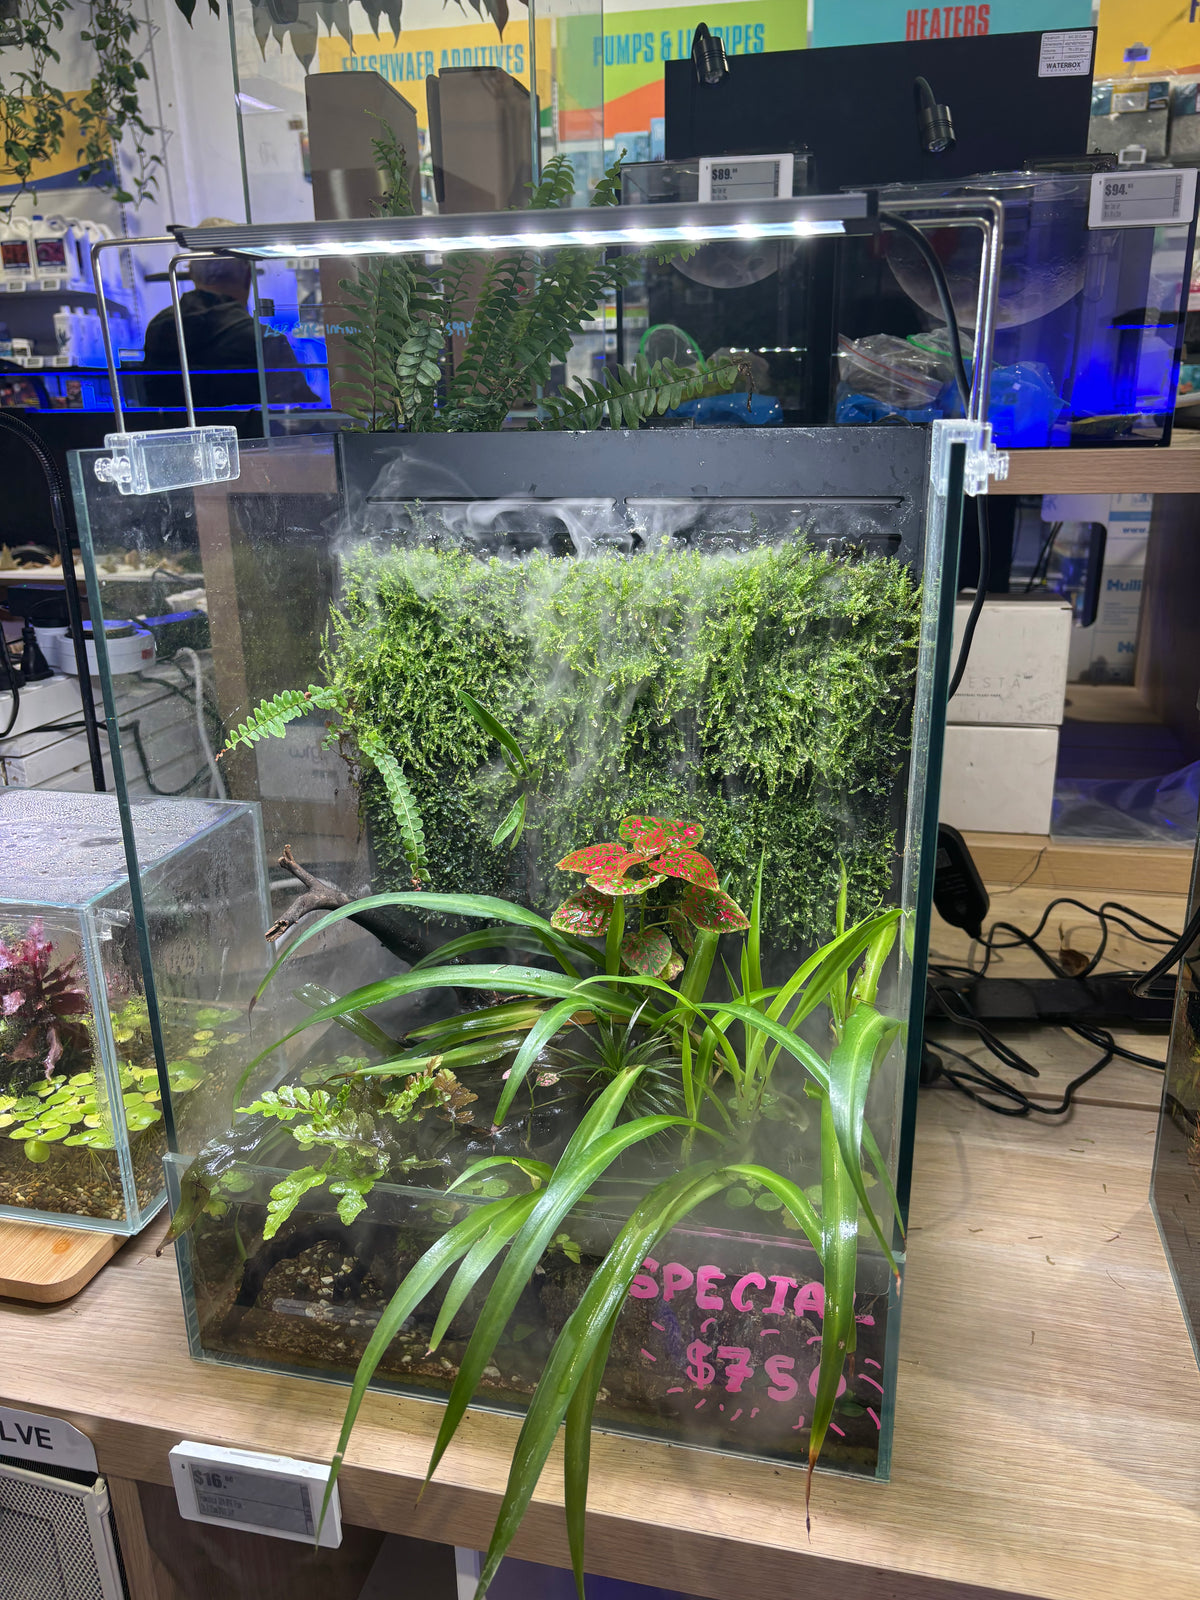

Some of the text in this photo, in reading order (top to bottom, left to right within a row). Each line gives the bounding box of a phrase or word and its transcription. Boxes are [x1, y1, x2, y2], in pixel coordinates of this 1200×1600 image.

[905, 4, 991, 42] HEATERS
[440, 43, 525, 75] ADDITIVES
[593, 32, 655, 67] PUMPS
[660, 31, 673, 61] &
[1046, 61, 1082, 69] WATERBOX
[685, 1338, 847, 1403] $750
